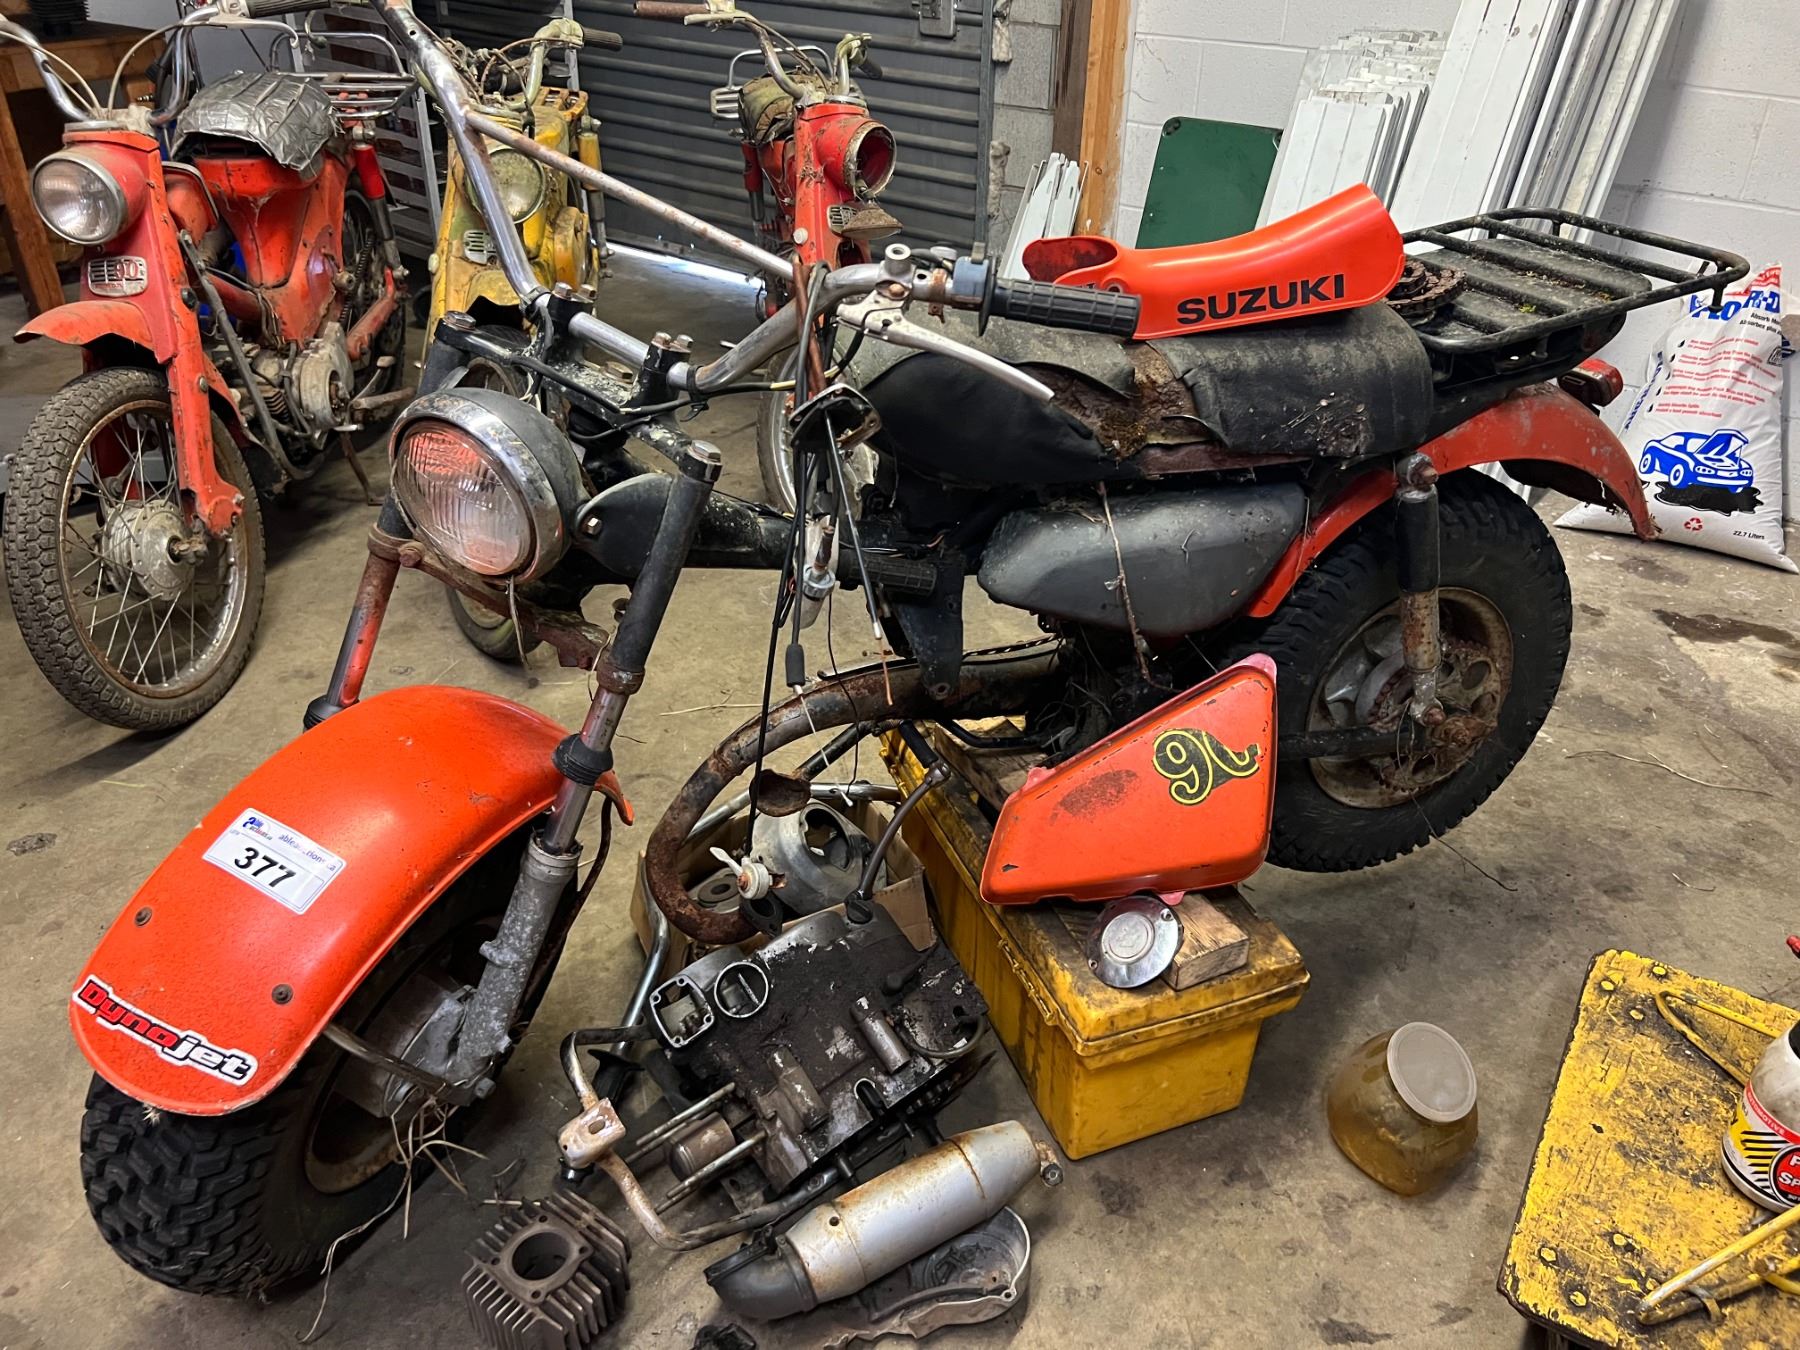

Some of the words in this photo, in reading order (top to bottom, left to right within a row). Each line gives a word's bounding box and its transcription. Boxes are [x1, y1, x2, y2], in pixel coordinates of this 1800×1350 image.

[1177, 264, 1345, 325] SUZUKI
[234, 847, 296, 887] 377
[77, 979, 253, 1080] Dynojet
